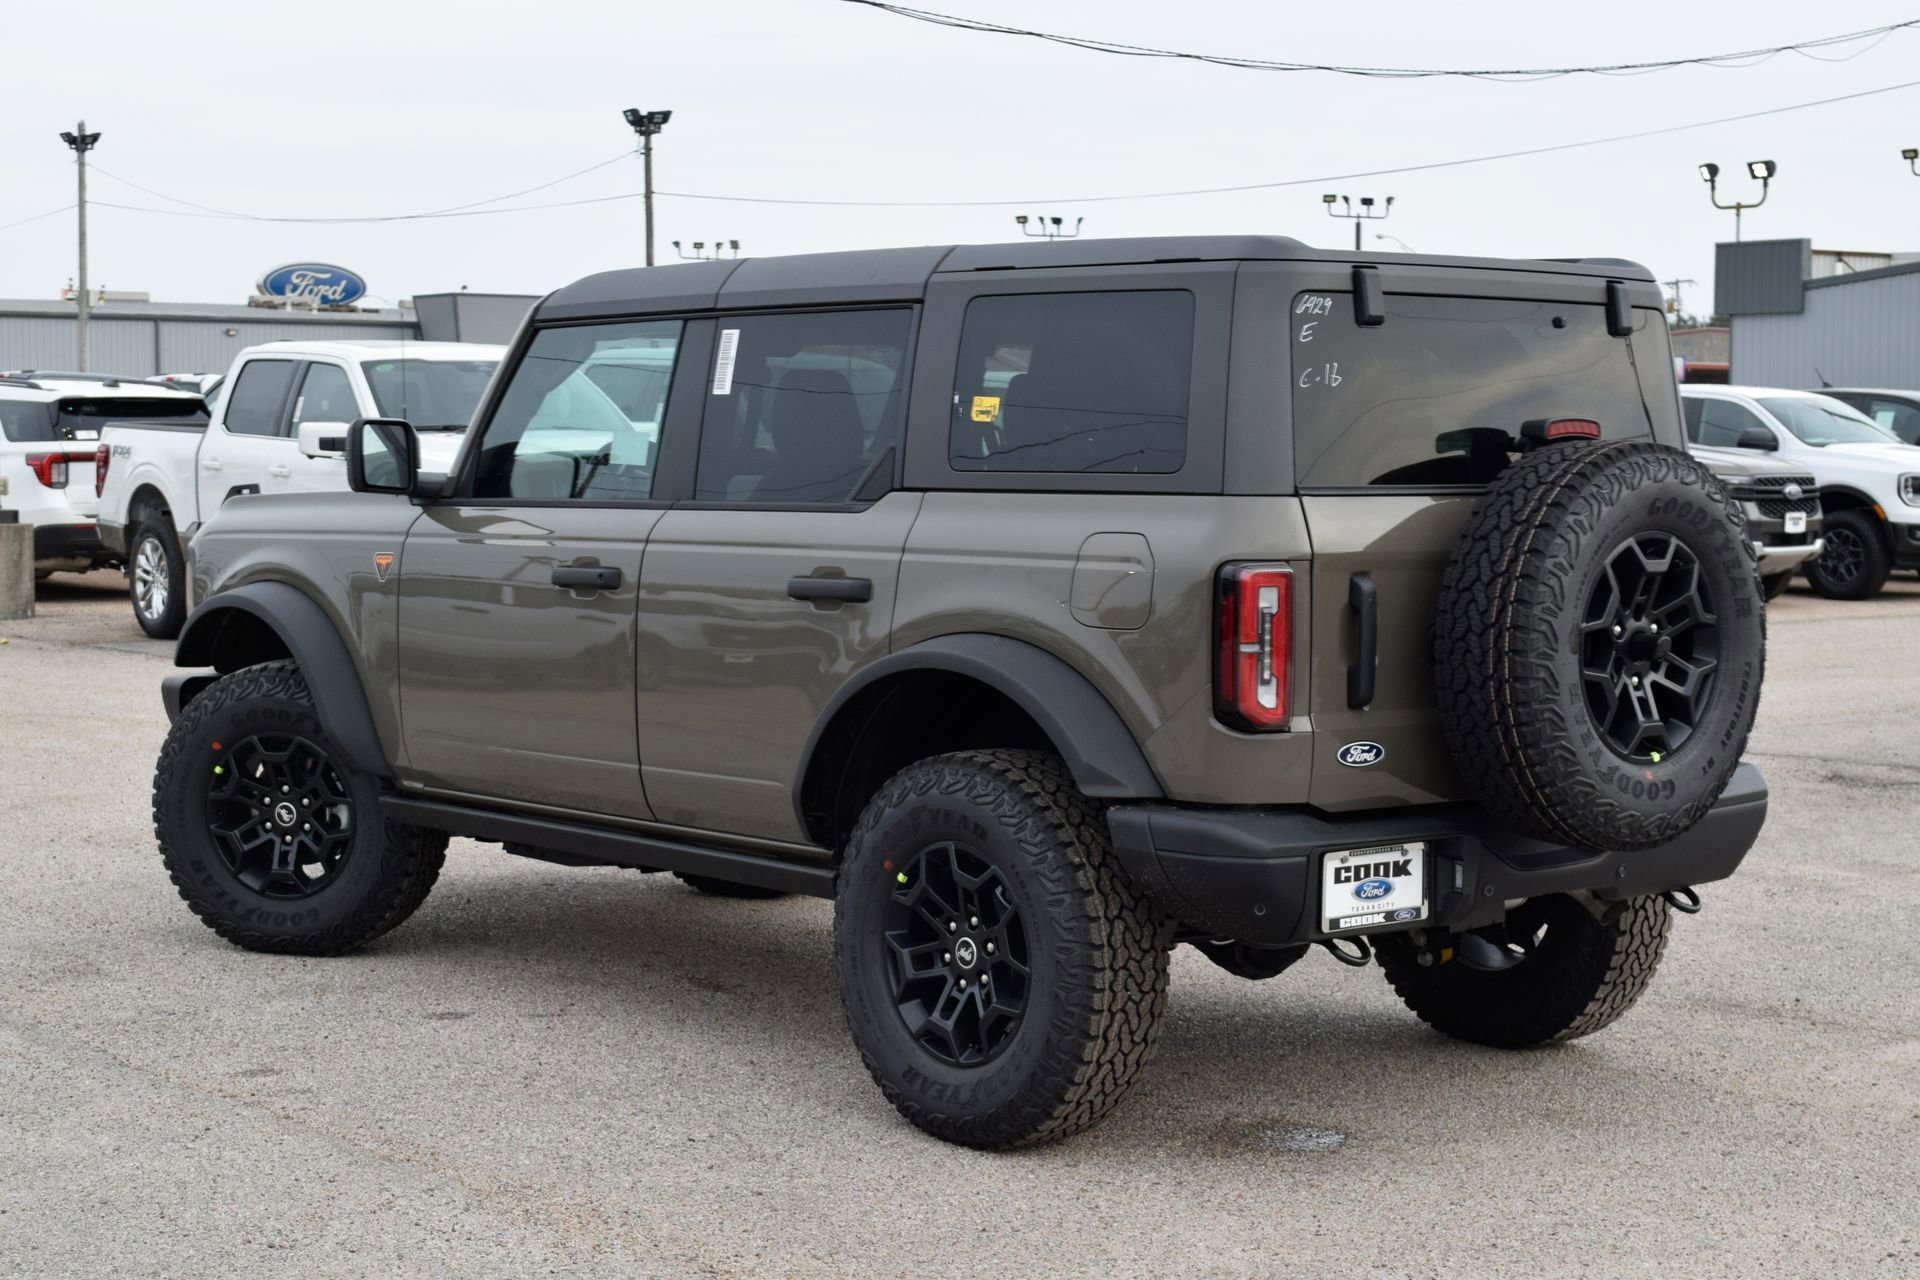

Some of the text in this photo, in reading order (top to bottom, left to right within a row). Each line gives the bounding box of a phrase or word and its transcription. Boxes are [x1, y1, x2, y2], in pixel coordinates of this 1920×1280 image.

[285, 270, 347, 300] Ford
[1299, 321, 1319, 342] E
[1720, 660, 1752, 751] TERRITORY
[1347, 745, 1376, 762] Ford
[1334, 859, 1413, 885] COOK
[1361, 882, 1386, 898] Ford
[1340, 913, 1386, 929] COOK
